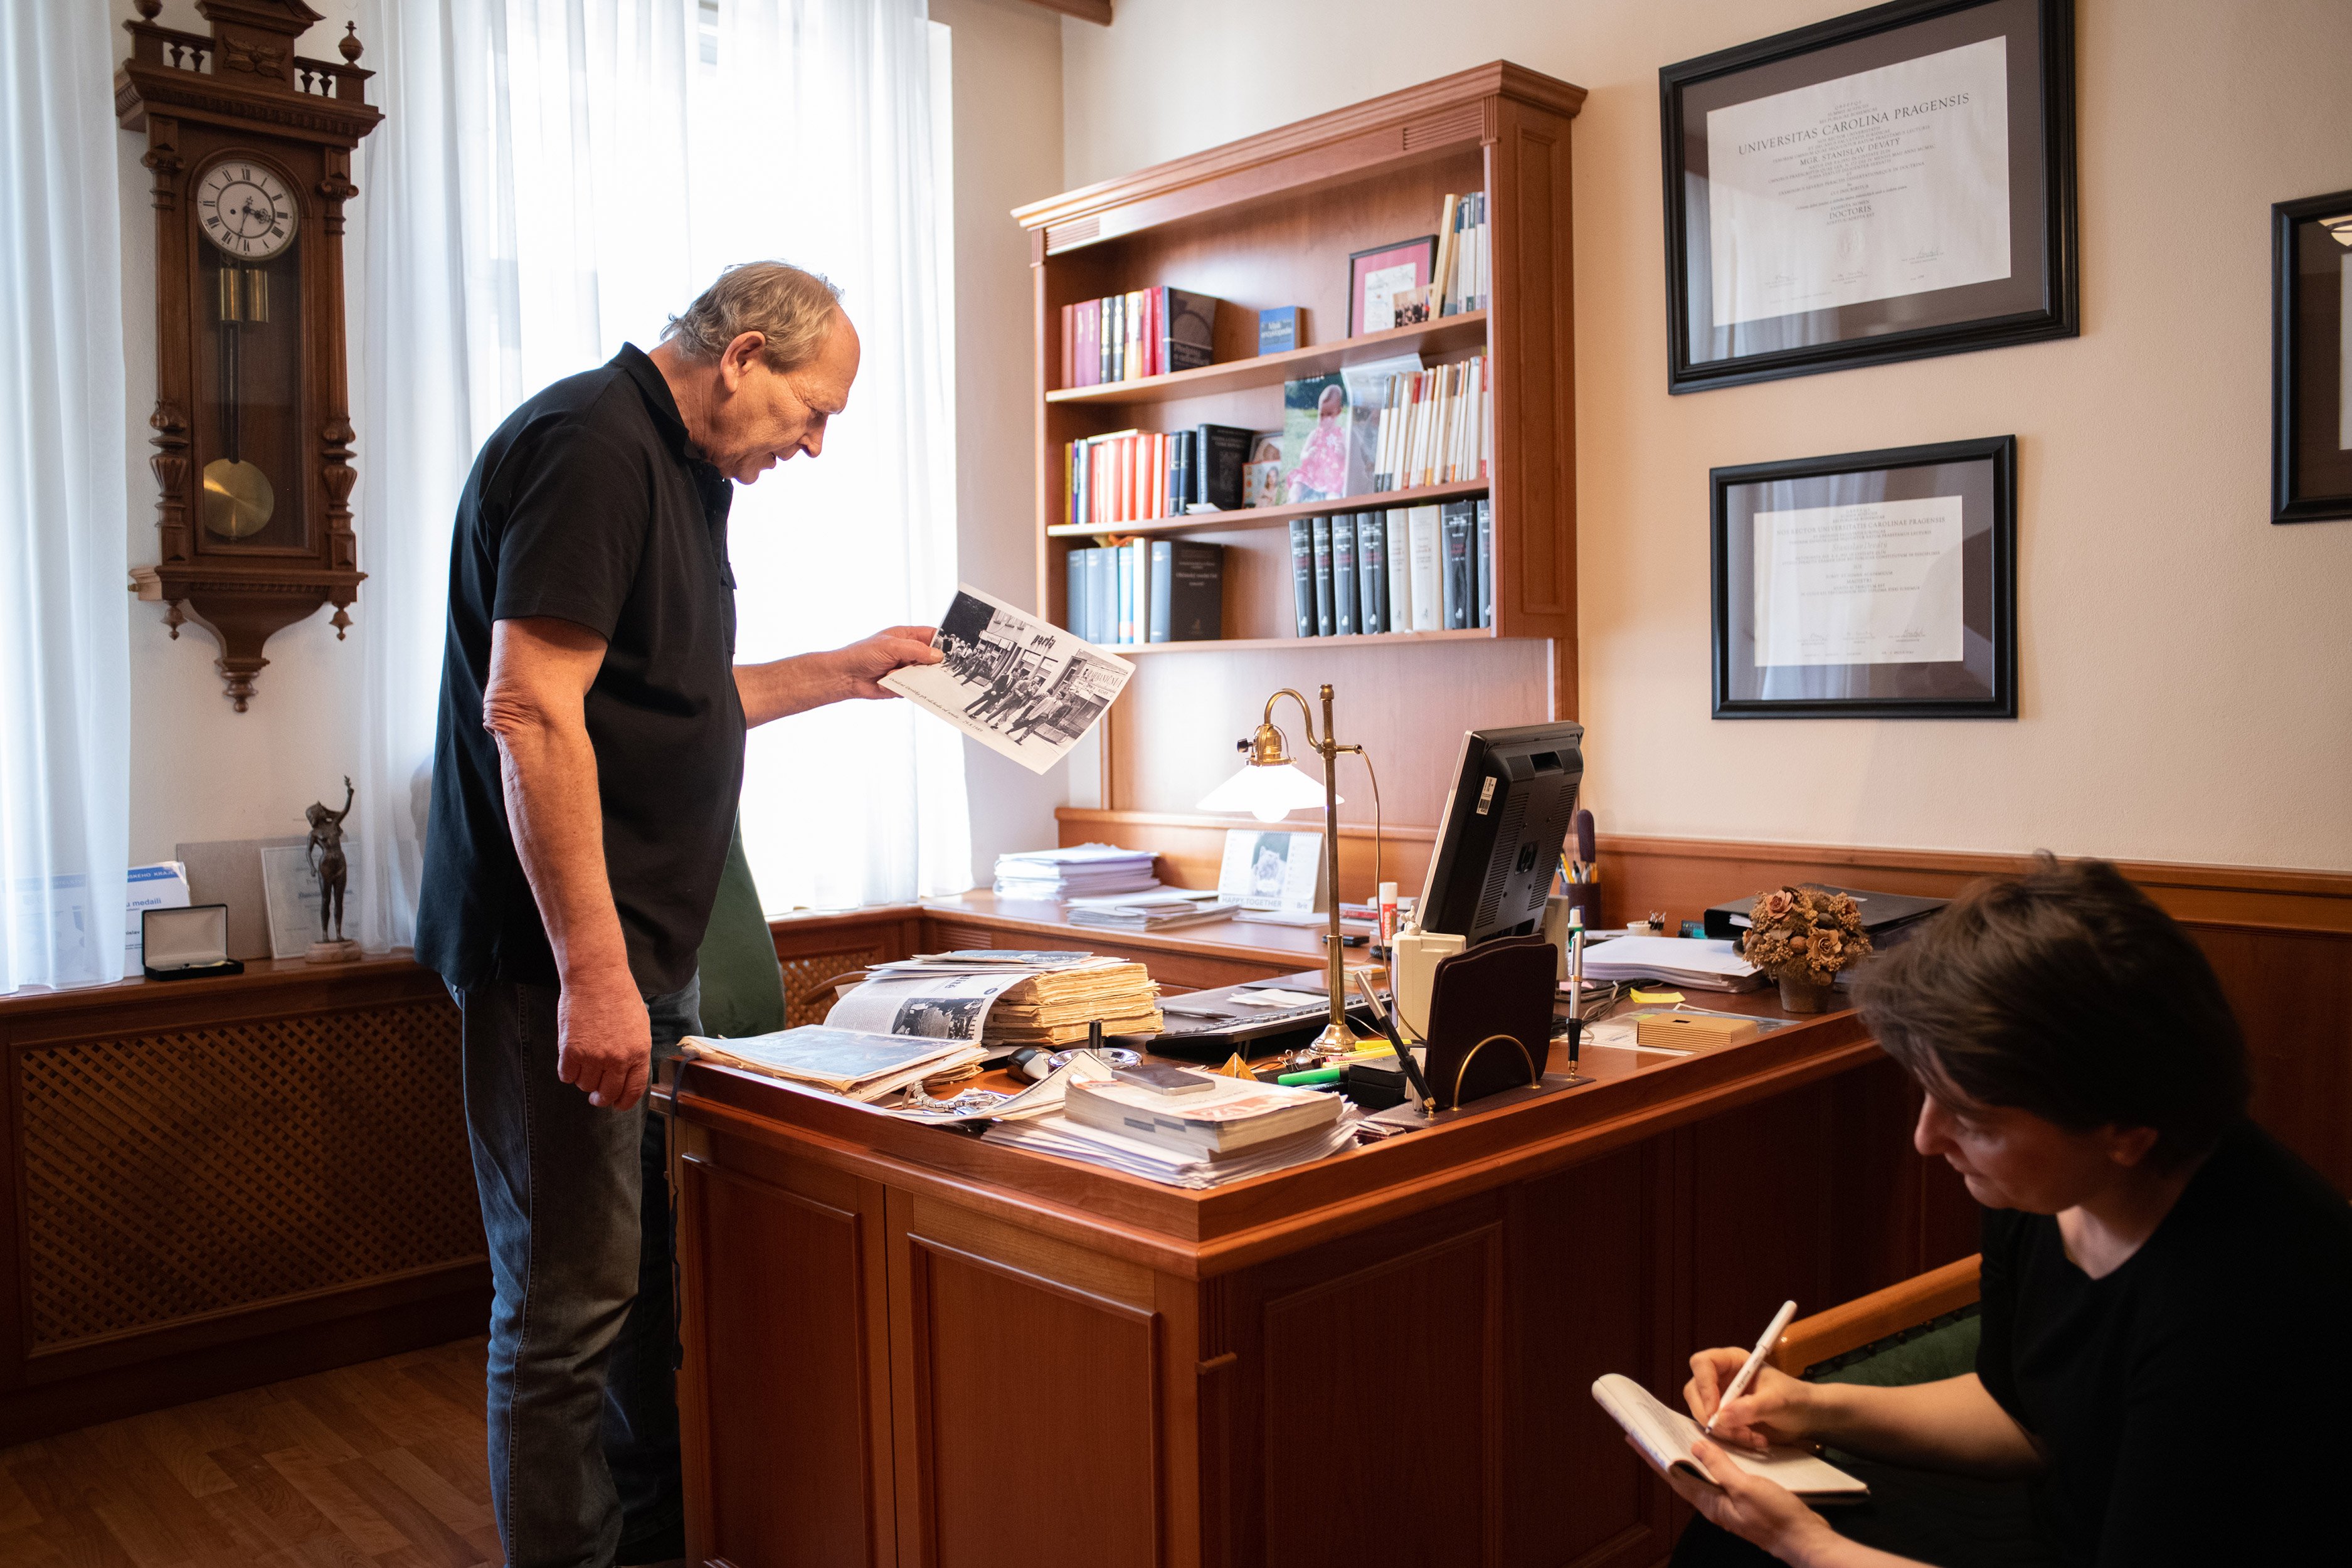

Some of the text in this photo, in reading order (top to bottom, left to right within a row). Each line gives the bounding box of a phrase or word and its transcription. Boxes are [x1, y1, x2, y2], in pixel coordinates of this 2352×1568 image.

[1738, 91, 1969, 156] UNIVERSITAS CAROLINA PRAGENSIS
[1821, 145, 1865, 161] STANISLAV
[1829, 204, 1872, 220] DOCTORIS
[1868, 519, 1907, 529] CAROLINAE
[1909, 516, 1945, 525] PRAGENSIS
[1030, 633, 1056, 649] perla
[132, 898, 161, 906] medaili
[1246, 898, 1282, 907] TOGETHER
